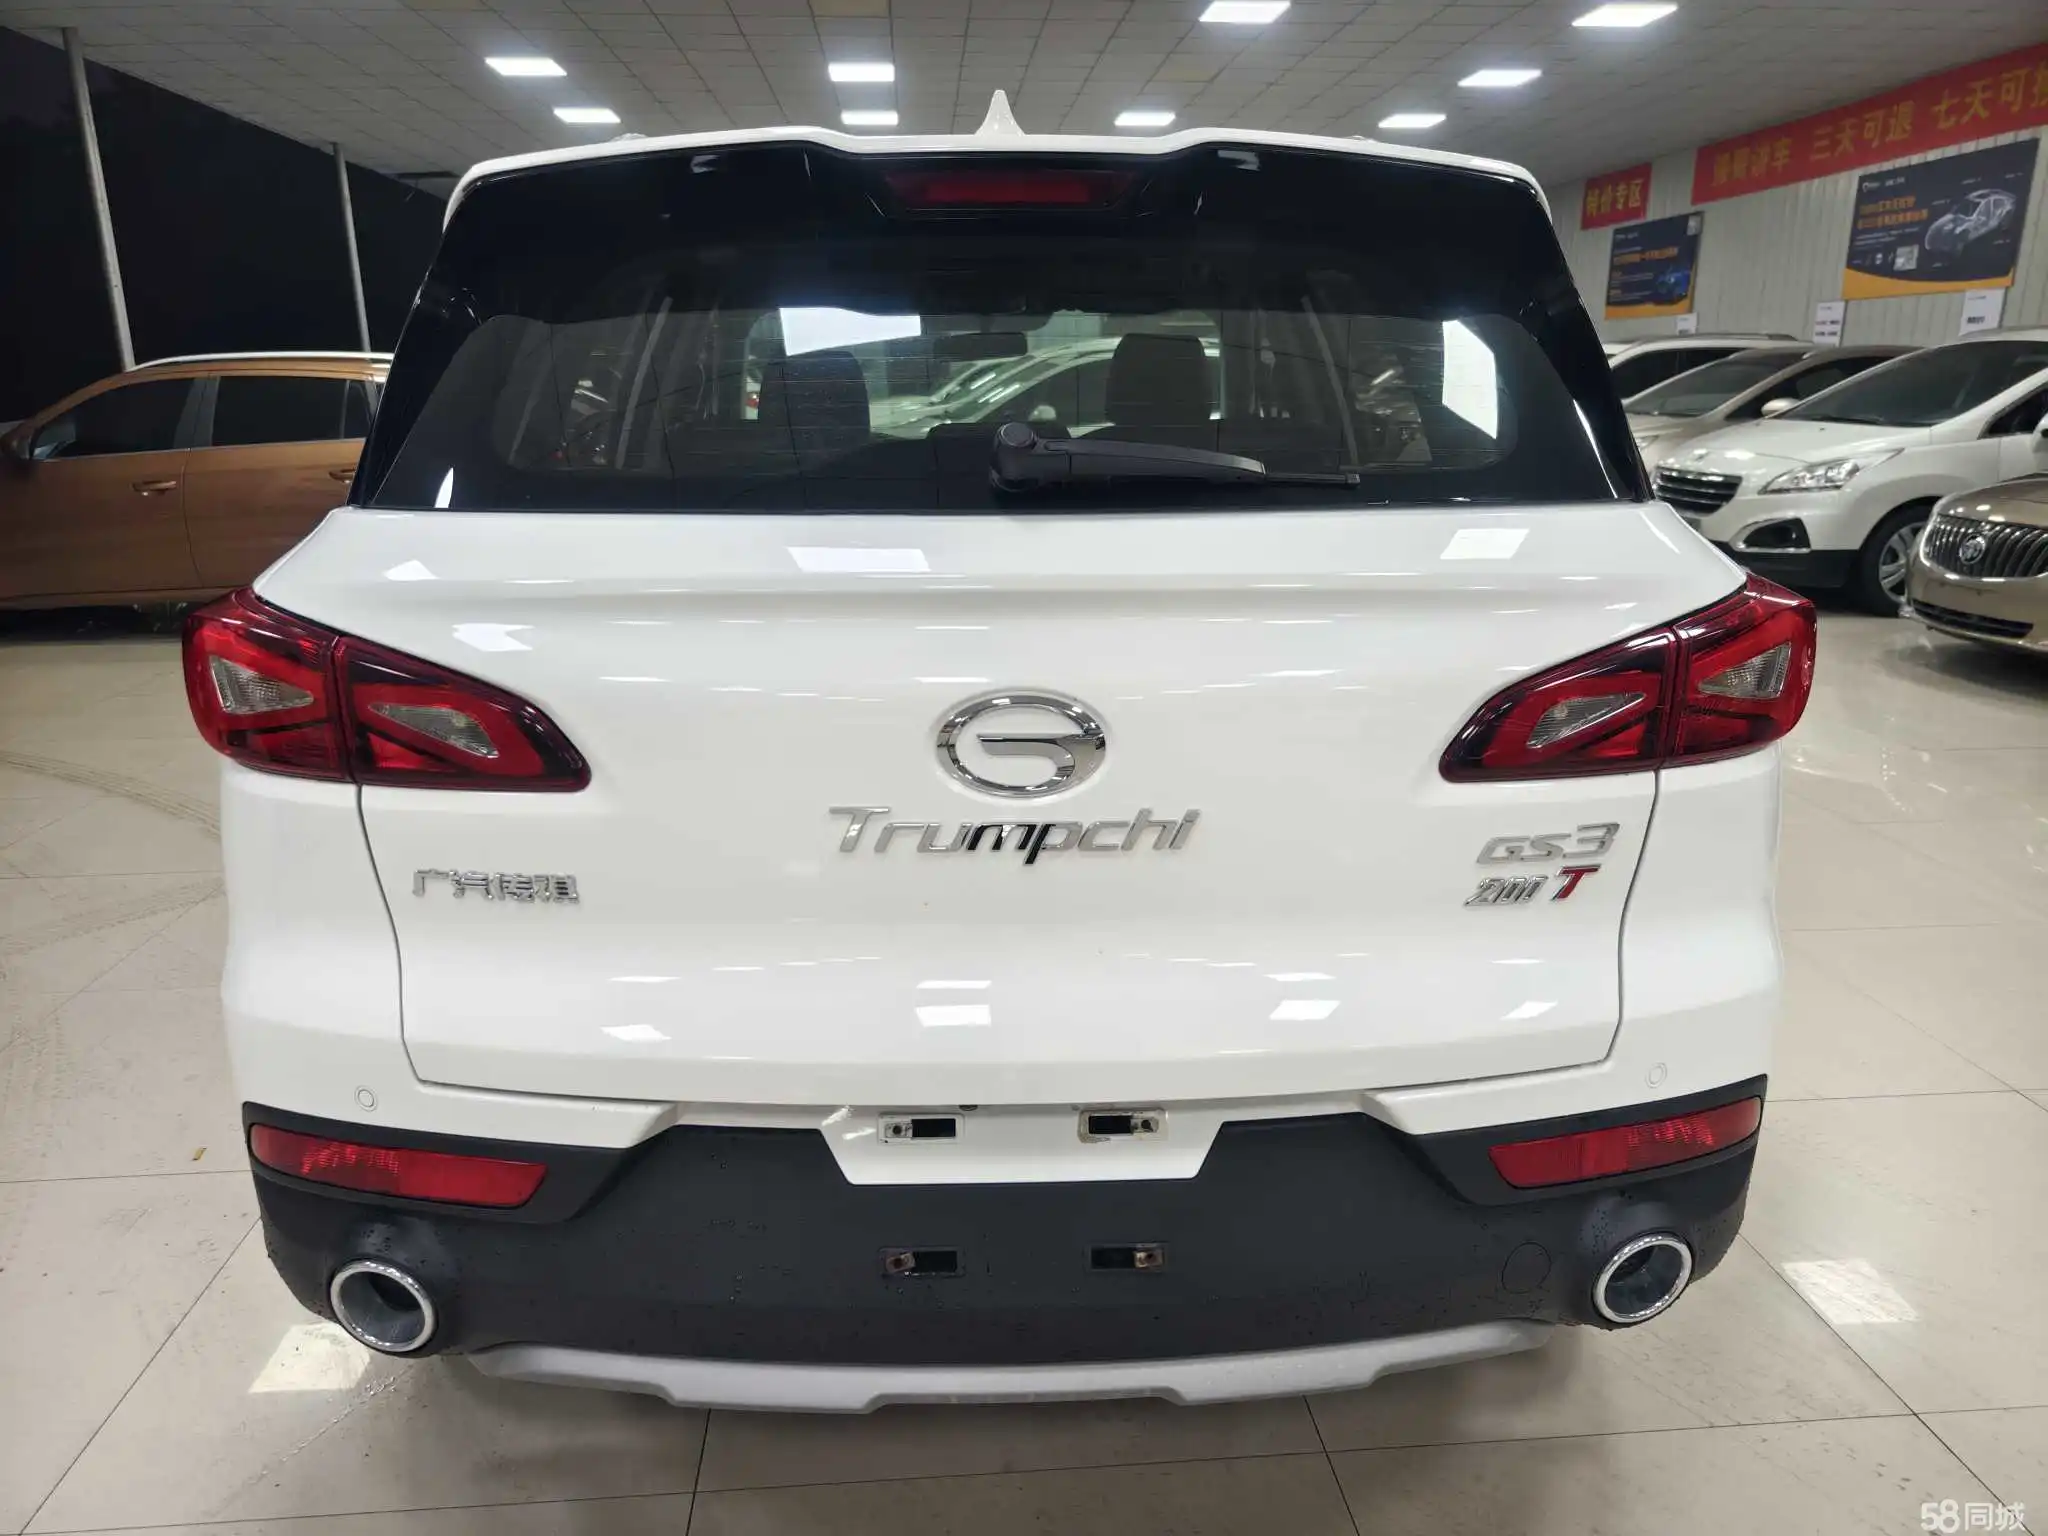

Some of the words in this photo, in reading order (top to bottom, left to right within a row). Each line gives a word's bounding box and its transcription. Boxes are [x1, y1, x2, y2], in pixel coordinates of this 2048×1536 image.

[1810, 100, 1915, 162] 三天可退
[1586, 178, 1644, 218] 特价专区
[829, 806, 1200, 865] Trumpchi
[1477, 822, 1620, 865] GS3
